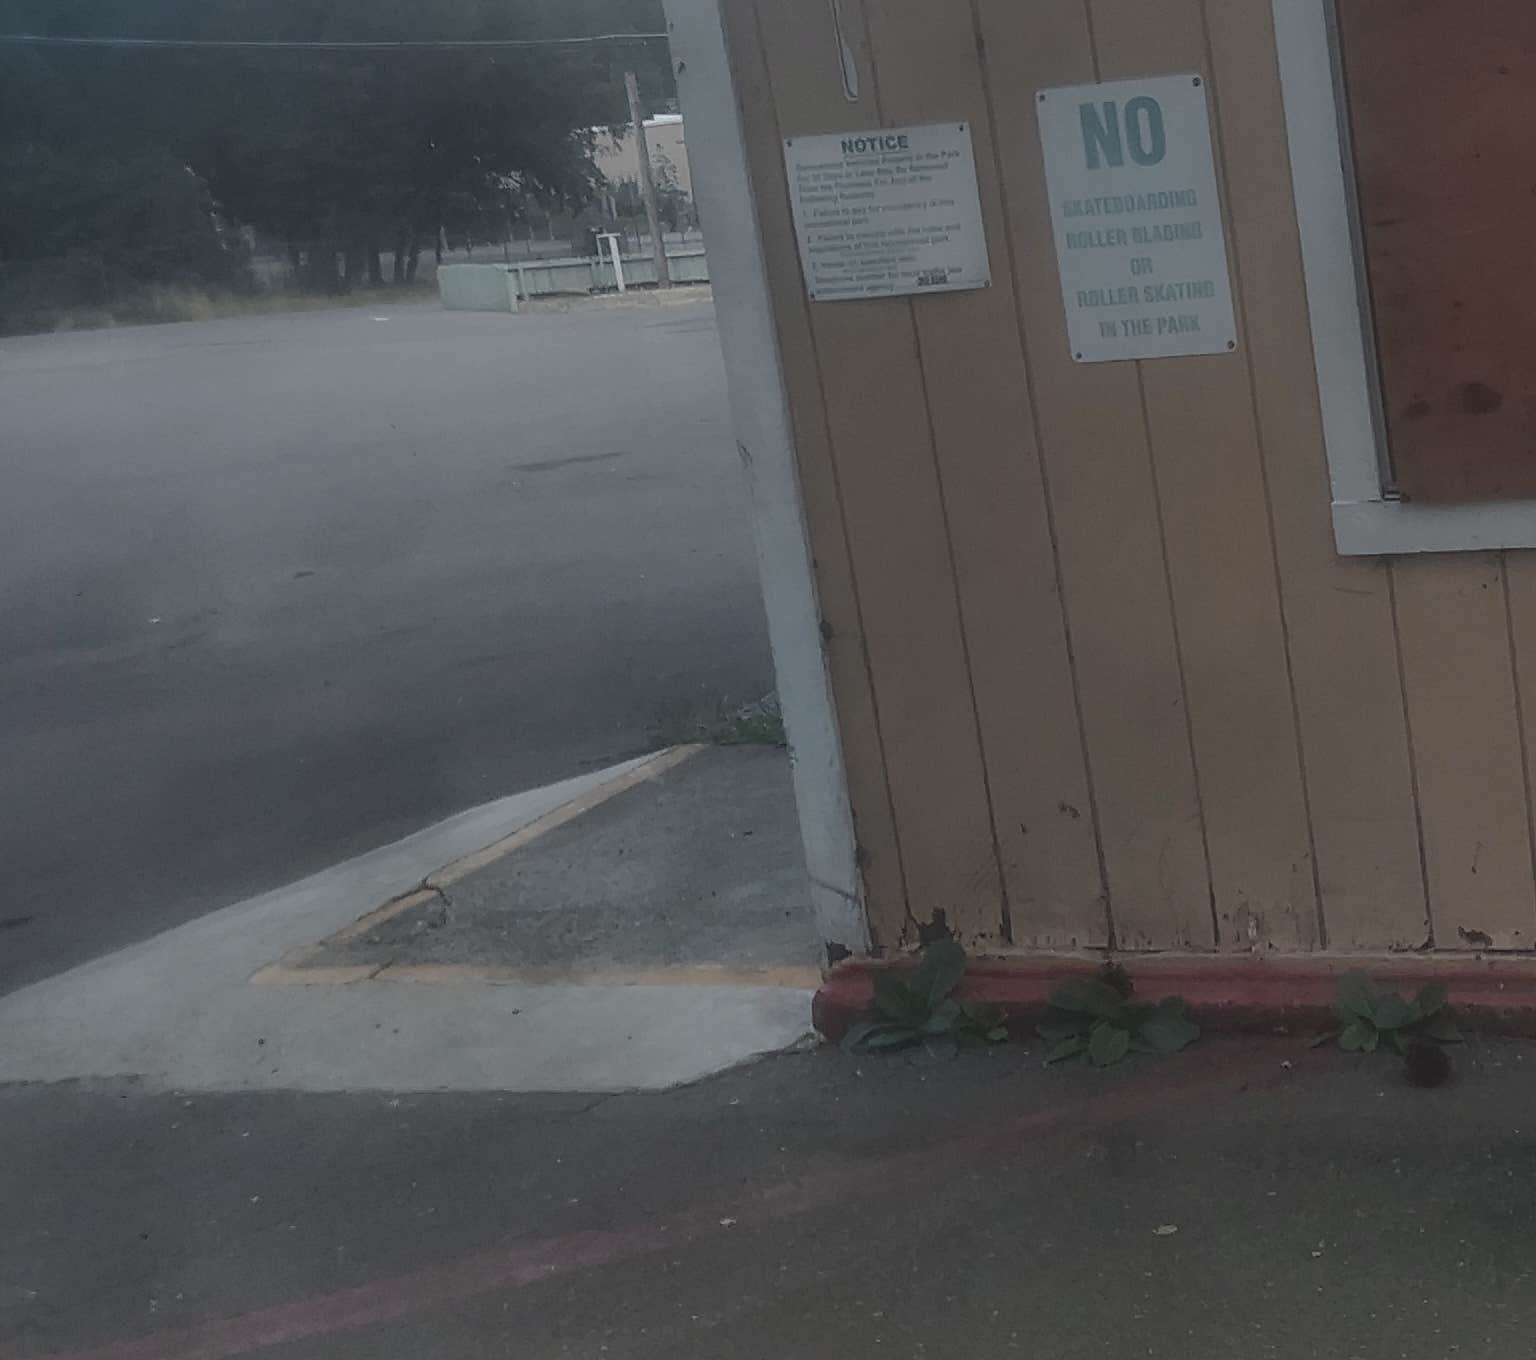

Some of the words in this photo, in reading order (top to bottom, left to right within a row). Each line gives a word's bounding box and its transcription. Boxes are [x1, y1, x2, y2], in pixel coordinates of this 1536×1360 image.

[840, 135, 910, 154] NOTICE
[1079, 95, 1167, 171] NO
[1062, 189, 1198, 218] SKATEBOARDING
[1066, 228, 1128, 250] ROLLER
[1132, 221, 1204, 245] BLADING
[1130, 257, 1153, 275] OR
[1077, 285, 1139, 308] ROLLER
[1144, 280, 1216, 303] SKATING
[1099, 320, 1117, 339] IN
[1121, 318, 1153, 337] THE
[1156, 314, 1201, 335] PARK
